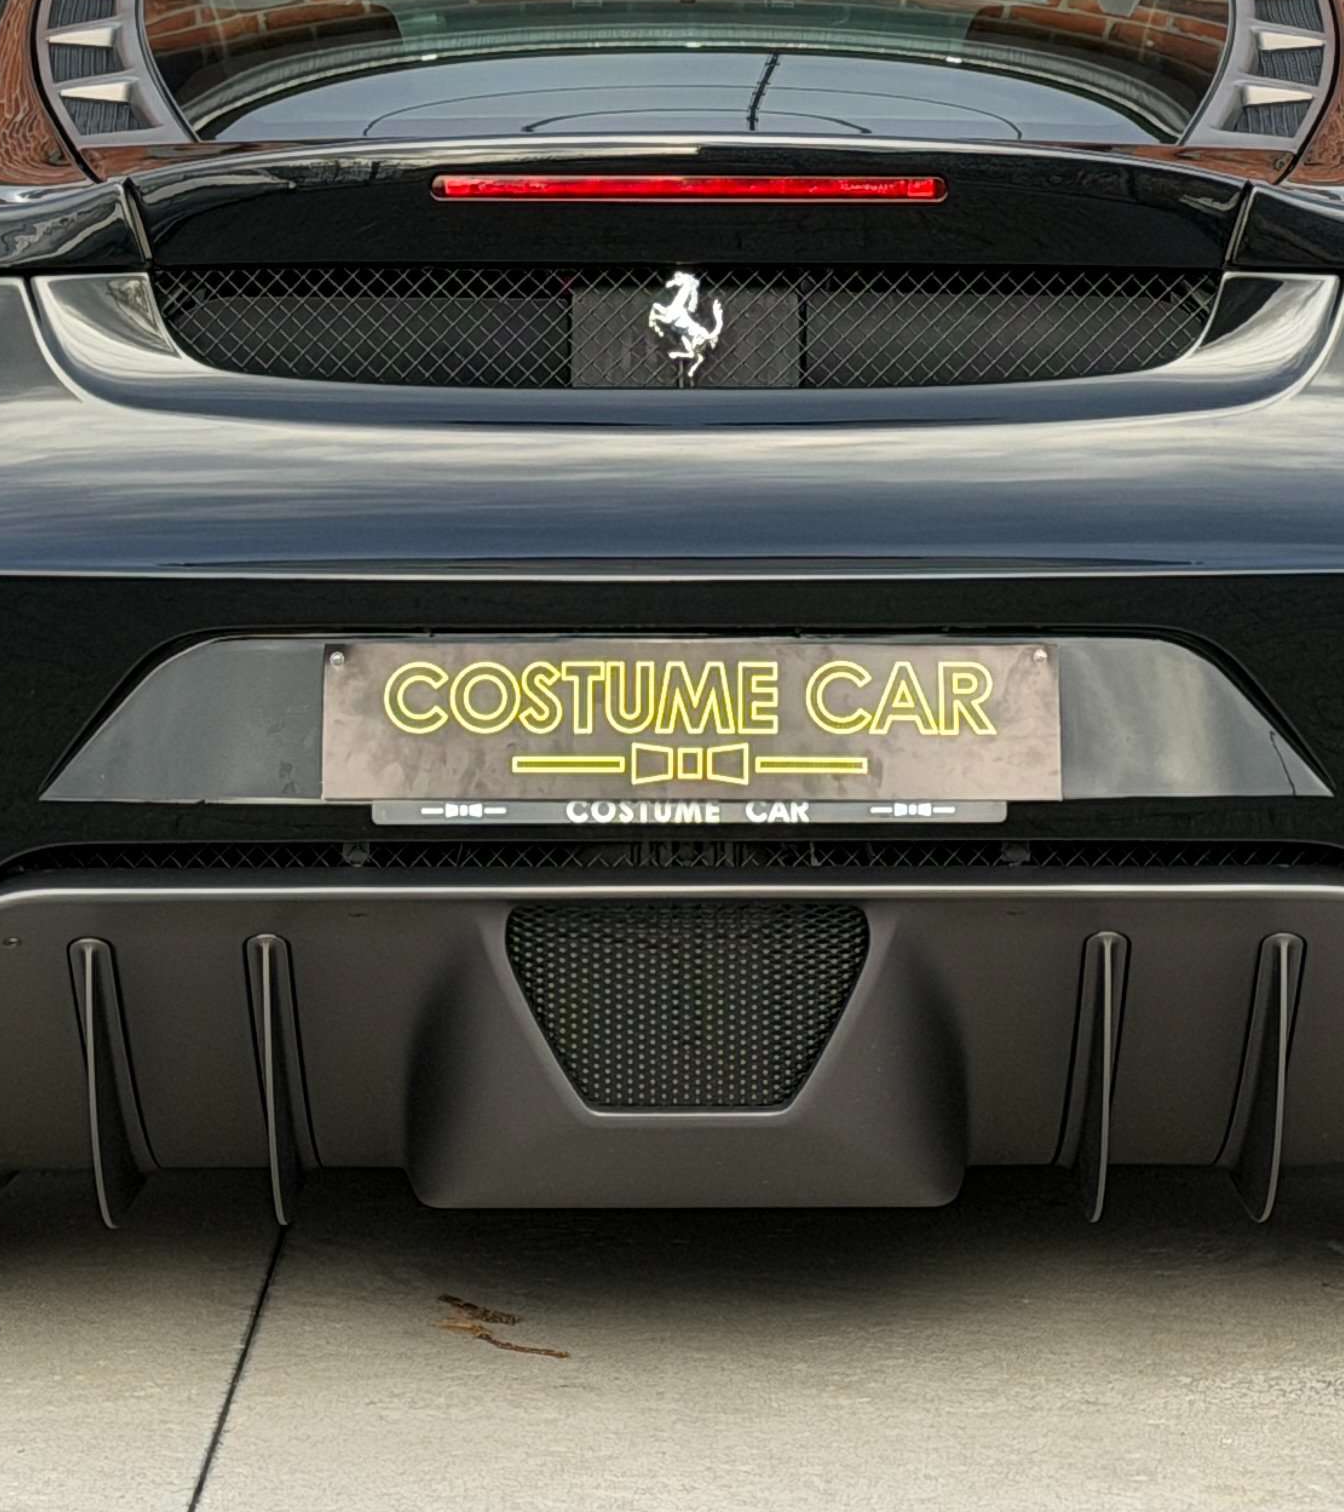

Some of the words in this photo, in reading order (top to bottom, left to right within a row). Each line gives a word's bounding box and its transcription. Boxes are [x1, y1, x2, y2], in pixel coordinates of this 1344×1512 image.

[383, 660, 779, 735] COSTUME
[806, 660, 997, 736] CAR
[566, 800, 721, 824] COSTUME
[744, 800, 810, 824] CAR
